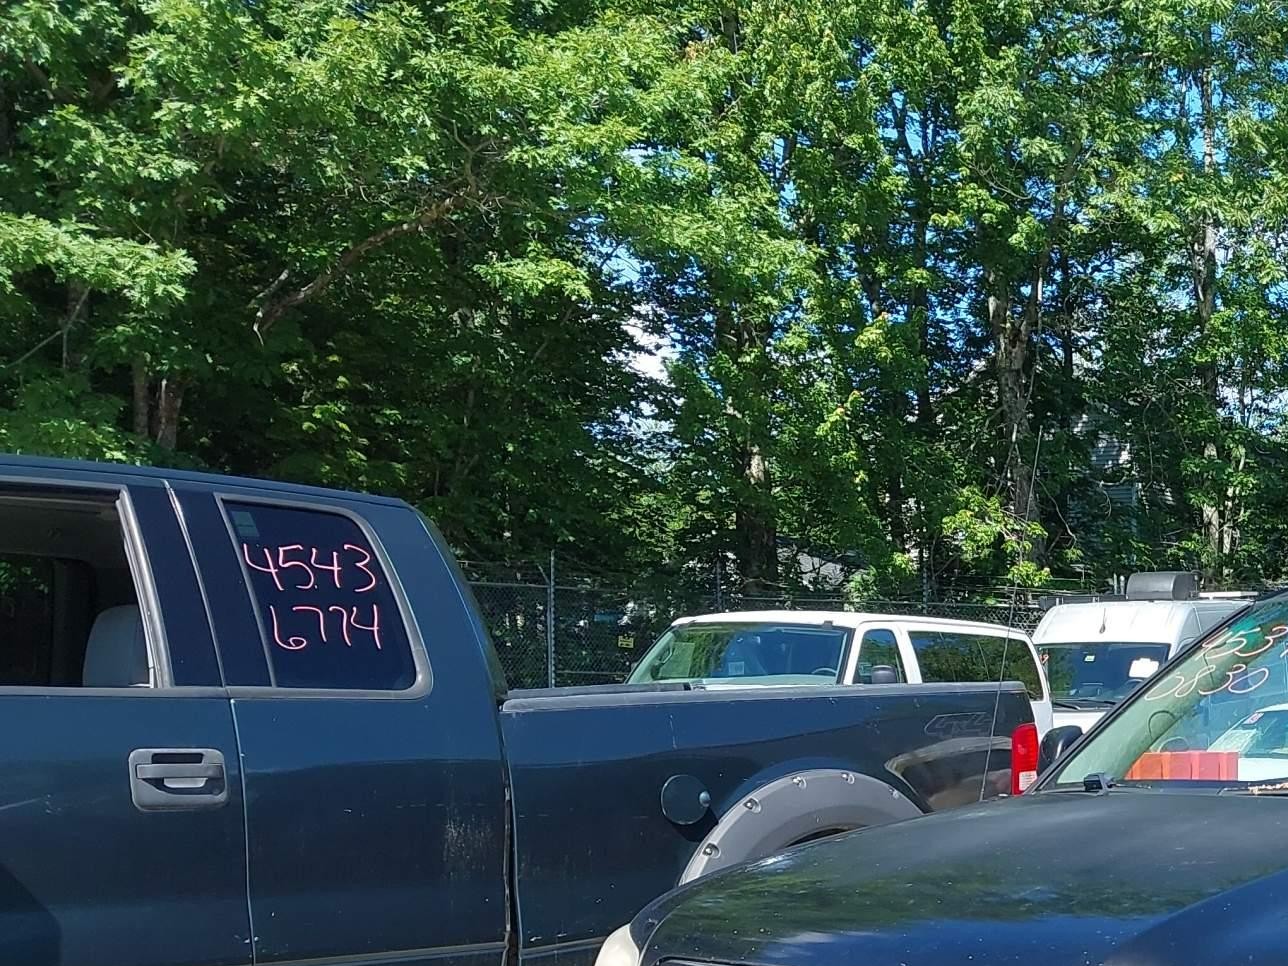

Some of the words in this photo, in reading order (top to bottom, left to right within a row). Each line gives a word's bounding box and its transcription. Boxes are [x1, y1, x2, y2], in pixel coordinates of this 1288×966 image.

[243, 543, 376, 592] 4543
[269, 604, 381, 650] 6774
[1144, 663, 1269, 701] 0830
